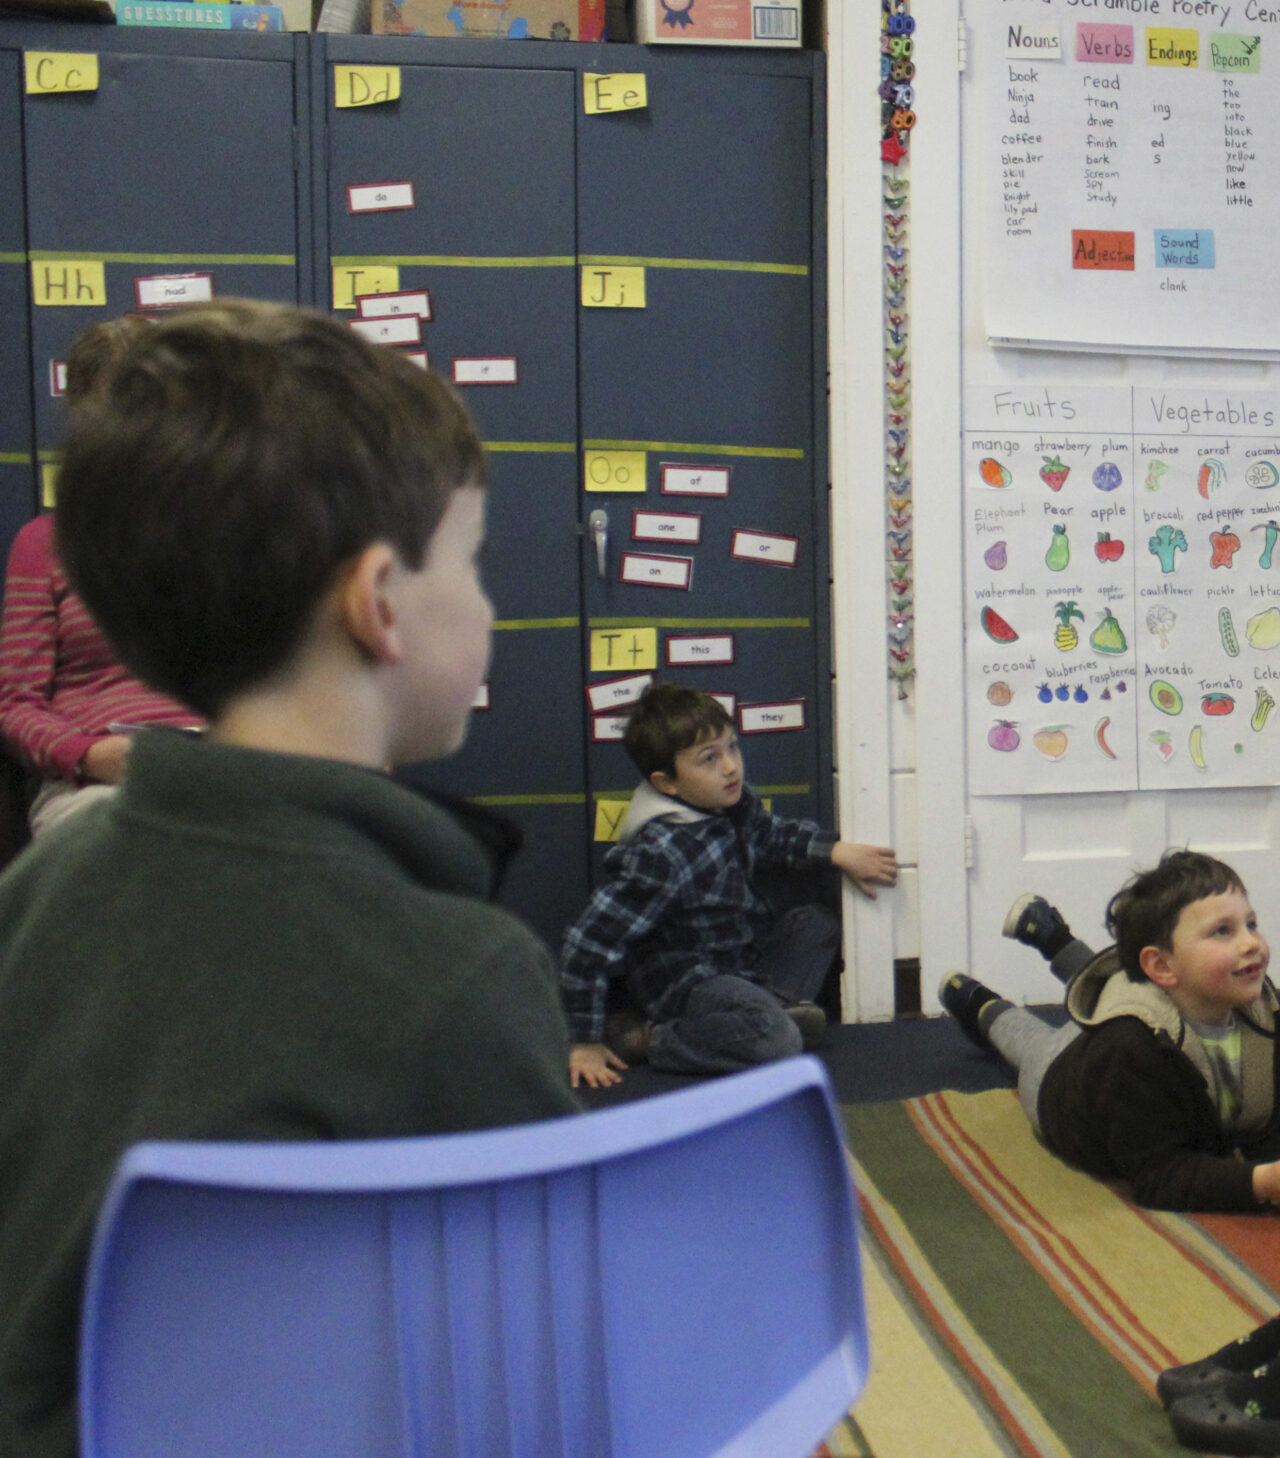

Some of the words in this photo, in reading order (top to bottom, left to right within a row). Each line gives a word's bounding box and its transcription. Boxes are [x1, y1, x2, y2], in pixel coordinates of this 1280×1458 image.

[124, 6, 224, 24] GUESSTURES
[1173, 0, 1231, 27] Poetry
[1007, 25, 1059, 48] Nouns
[1081, 32, 1132, 58] Verbs
[1148, 38, 1198, 66] Endings
[1210, 42, 1250, 69] Popcorn
[1008, 64, 1039, 82] book
[1083, 73, 1120, 90] read
[1222, 79, 1234, 87] to
[1008, 88, 1035, 107] Ninja
[1222, 89, 1240, 98] the
[1083, 93, 1119, 110] train
[1009, 108, 1031, 124] dad
[1153, 103, 1171, 120] ing
[1087, 112, 1114, 127] drive
[1224, 124, 1253, 136] black
[1001, 133, 1042, 144] coffee
[1086, 134, 1117, 148] finish
[1151, 132, 1165, 148] ed
[1224, 137, 1248, 149] blue
[1001, 152, 1044, 165] blender
[1086, 154, 1110, 165] bark
[1225, 150, 1256, 162] yellow
[1226, 178, 1246, 190] like
[1227, 194, 1254, 207] little
[1161, 232, 1199, 249] Sound
[1162, 251, 1199, 265] Words
[1160, 277, 1187, 291] clank
[994, 388, 1076, 419] Fruits
[1151, 394, 1274, 433] Vegetables
[972, 440, 1020, 456] mango
[1034, 435, 1091, 456] strawberry
[1102, 438, 1128, 457] plum
[1140, 441, 1179, 455] kimchee
[1197, 440, 1231, 455] carrot
[690, 476, 701, 485] of
[974, 503, 1026, 521] Elephant
[1043, 502, 1074, 516] Pear
[1091, 502, 1126, 522] apple
[1143, 508, 1184, 522] broccoli
[1197, 508, 1214, 521] red
[1216, 508, 1245, 523] pepper
[658, 524, 675, 532] one
[759, 544, 771, 552] or
[649, 567, 661, 575] on
[975, 582, 1036, 599] watermelon
[1140, 584, 1193, 597] cauliflower
[1207, 585, 1235, 599] pickle
[691, 646, 710, 655] this
[982, 656, 1036, 674] coconut
[1045, 661, 1098, 678] bluberries
[1145, 662, 1193, 677] Avocado
[1089, 666, 1137, 684] raspberries
[1198, 675, 1243, 690] Tomato
[613, 688, 630, 697] the
[761, 713, 783, 722] they
